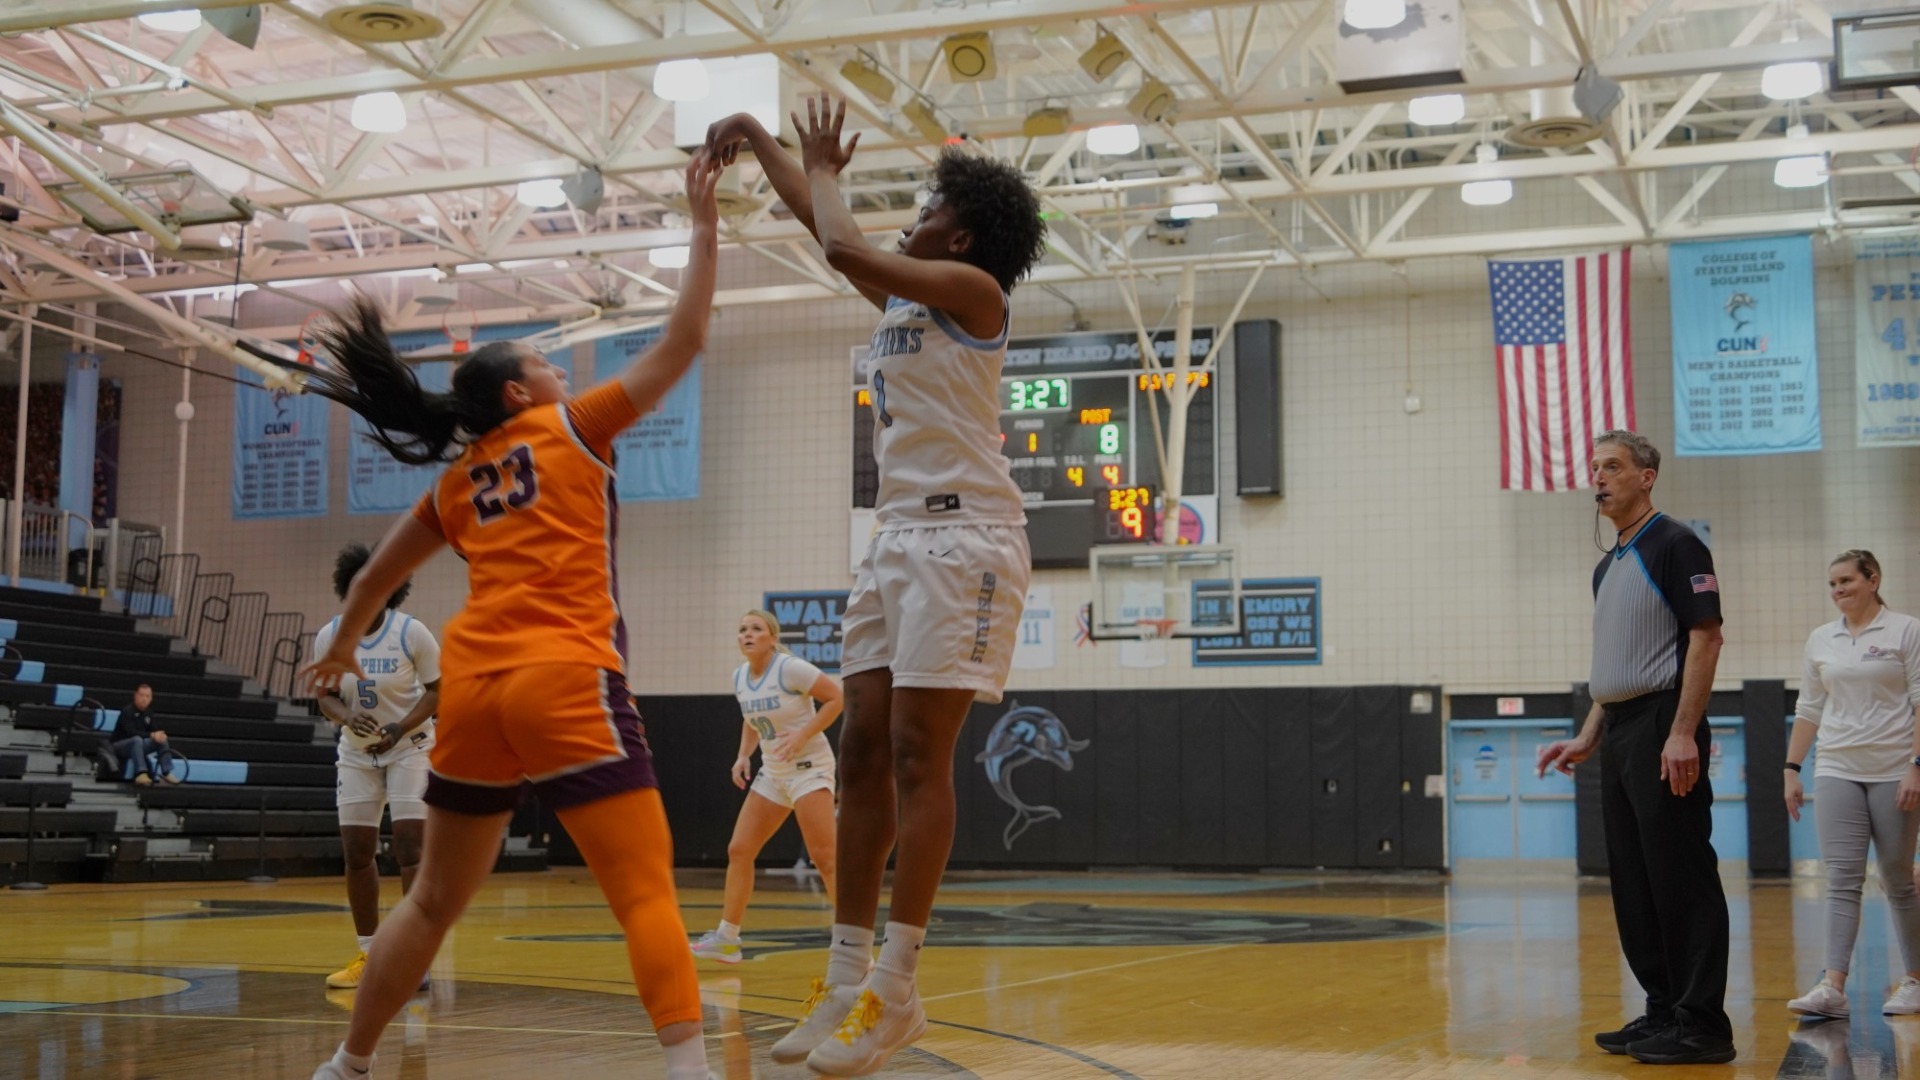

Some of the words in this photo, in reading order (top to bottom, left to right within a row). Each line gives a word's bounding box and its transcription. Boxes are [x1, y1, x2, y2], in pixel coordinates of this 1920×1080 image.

[1702, 252, 1758, 264] COLLEGE
[1760, 251, 1777, 260] OF
[1694, 264, 1738, 276] STATEN
[1742, 261, 1785, 273] ISLAND
[1710, 274, 1770, 286] DOLPHINS
[1687, 360, 1724, 371] MEN'S
[1728, 356, 1802, 369] BASKETBALL
[1710, 370, 1781, 382] CHAMPIONS
[1009, 379, 1069, 411] 3:27
[1028, 432, 1038, 453] 1
[1100, 424, 1119, 454] 8
[1009, 457, 1034, 469] LAYER
[469, 443, 539, 525] 23
[1067, 466, 1084, 488] 4
[1103, 465, 1120, 486] 4
[1109, 487, 1150, 511] 3:27
[1121, 507, 1143, 538] 9
[773, 599, 843, 624] WAL
[1199, 598, 1220, 615] IN
[1247, 615, 1279, 630] OSE
[1283, 614, 1313, 629] WE
[806, 625, 834, 643] OF
[1023, 621, 1042, 645] 11
[1249, 631, 1275, 647] ON
[361, 657, 399, 674] PHINS
[357, 679, 379, 710] 5
